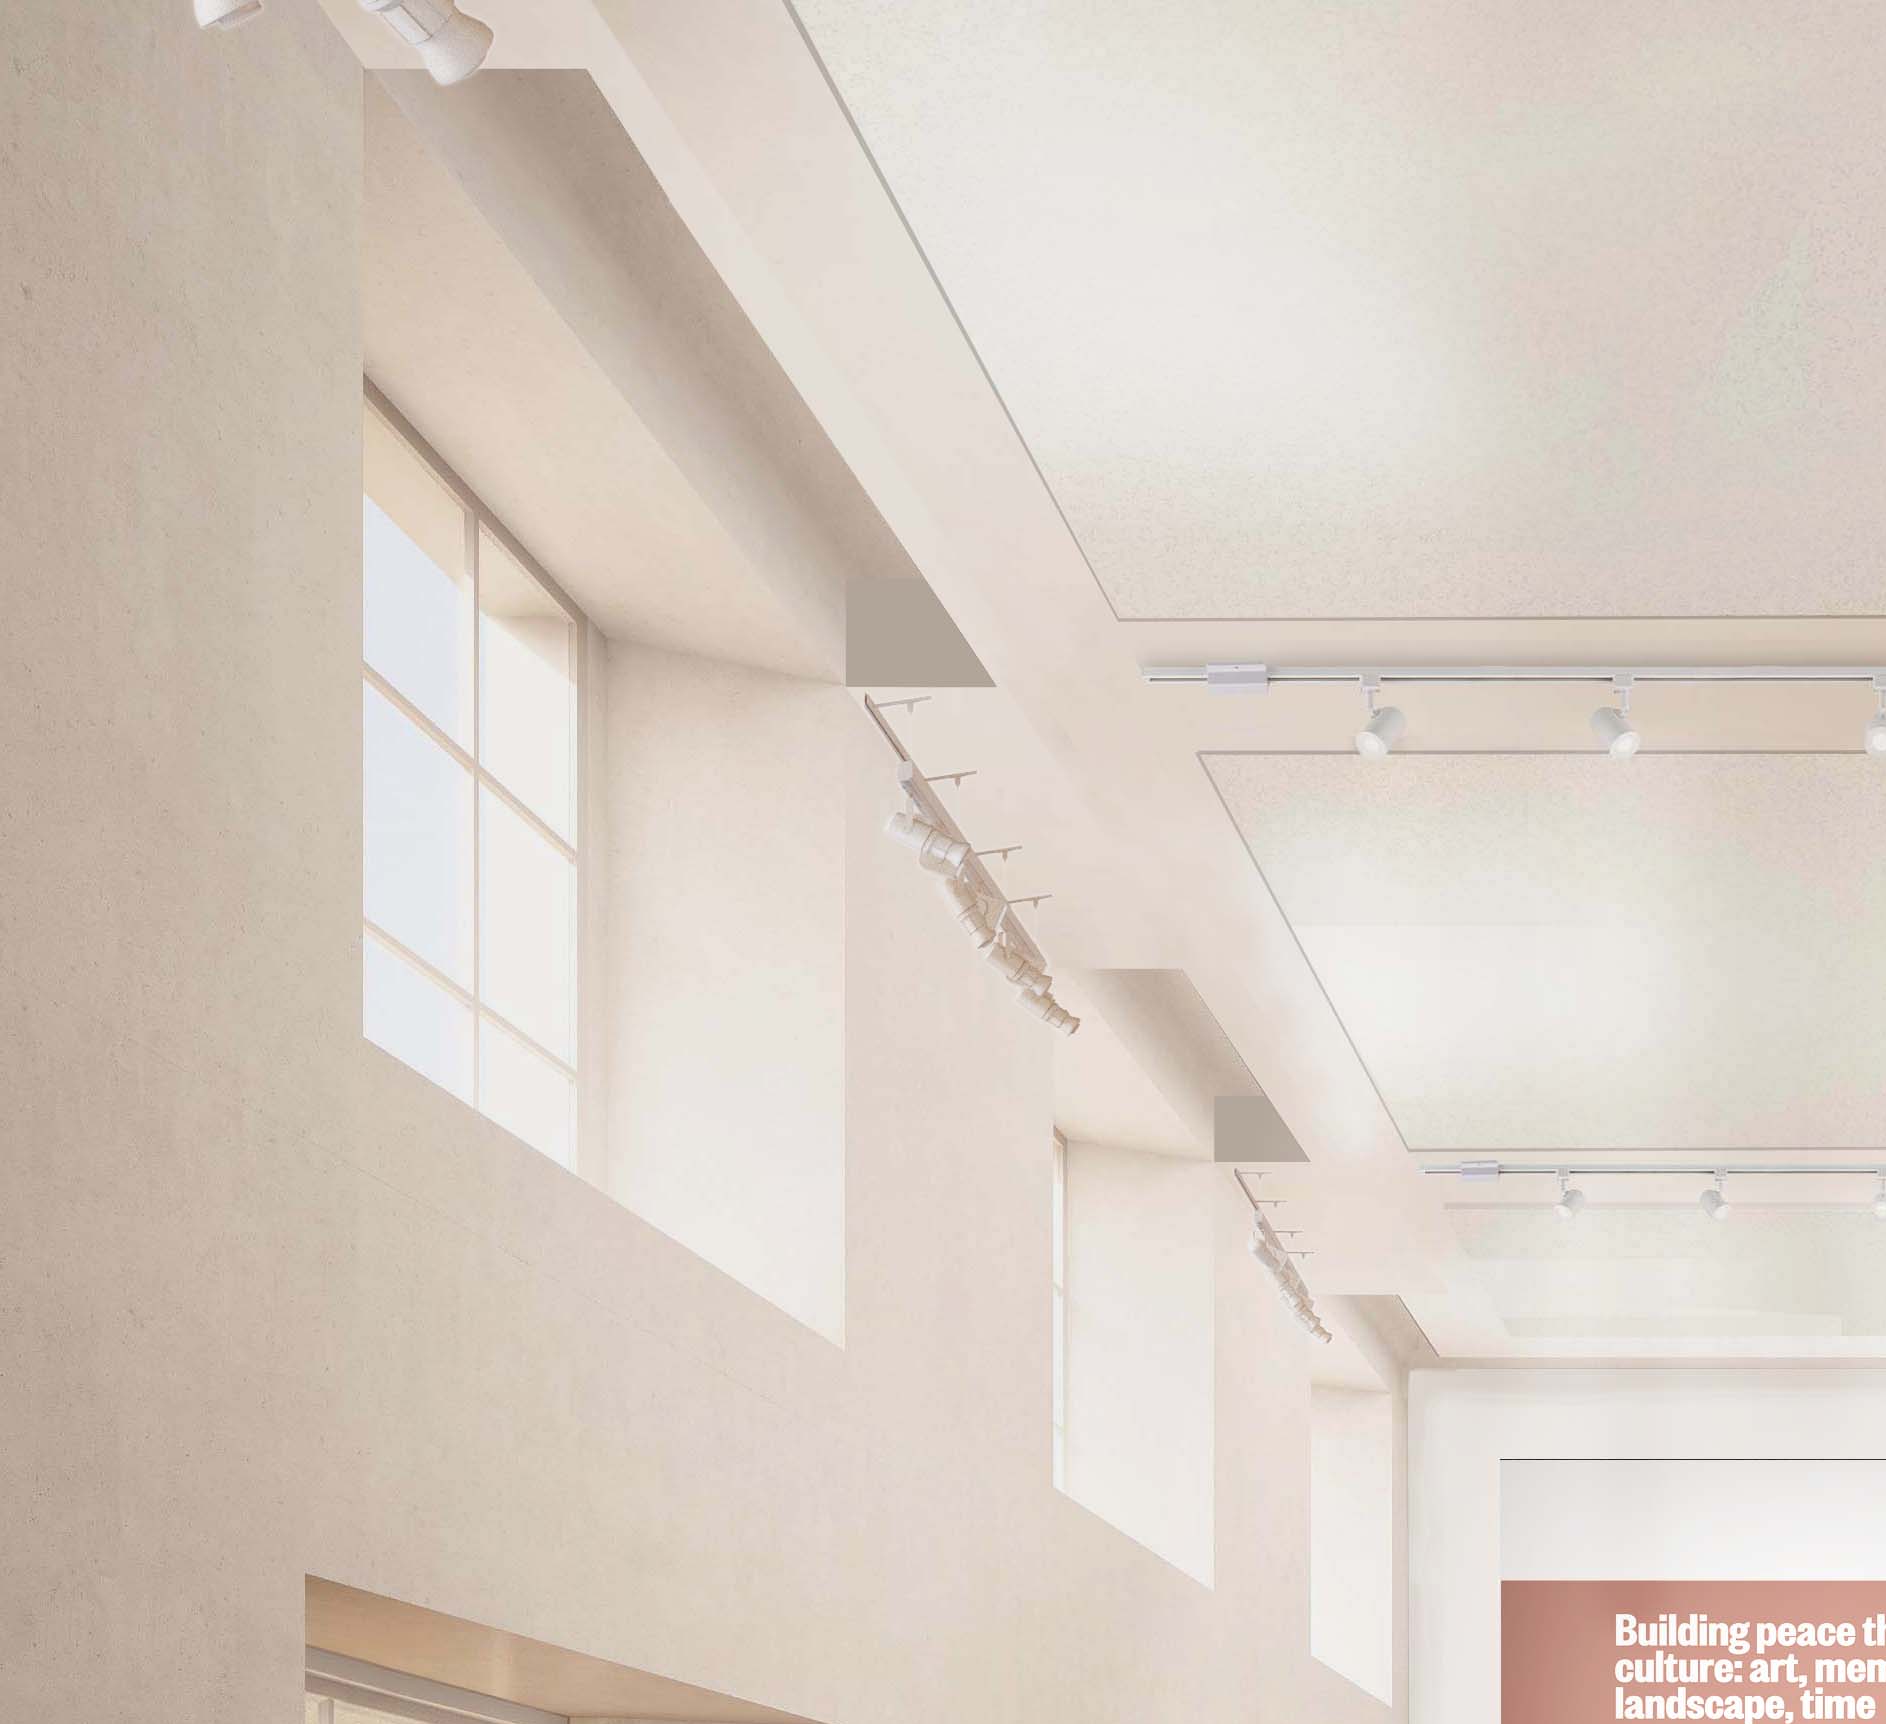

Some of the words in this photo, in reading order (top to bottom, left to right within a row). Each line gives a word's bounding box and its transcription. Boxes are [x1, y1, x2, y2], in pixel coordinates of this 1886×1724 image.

[1615, 1613, 1751, 1655] Building
[1756, 1622, 1856, 1655] peace
[1614, 1650, 1743, 1683] culture:
[1749, 1653, 1808, 1689] art,
[1799, 1686, 1876, 1720] time
